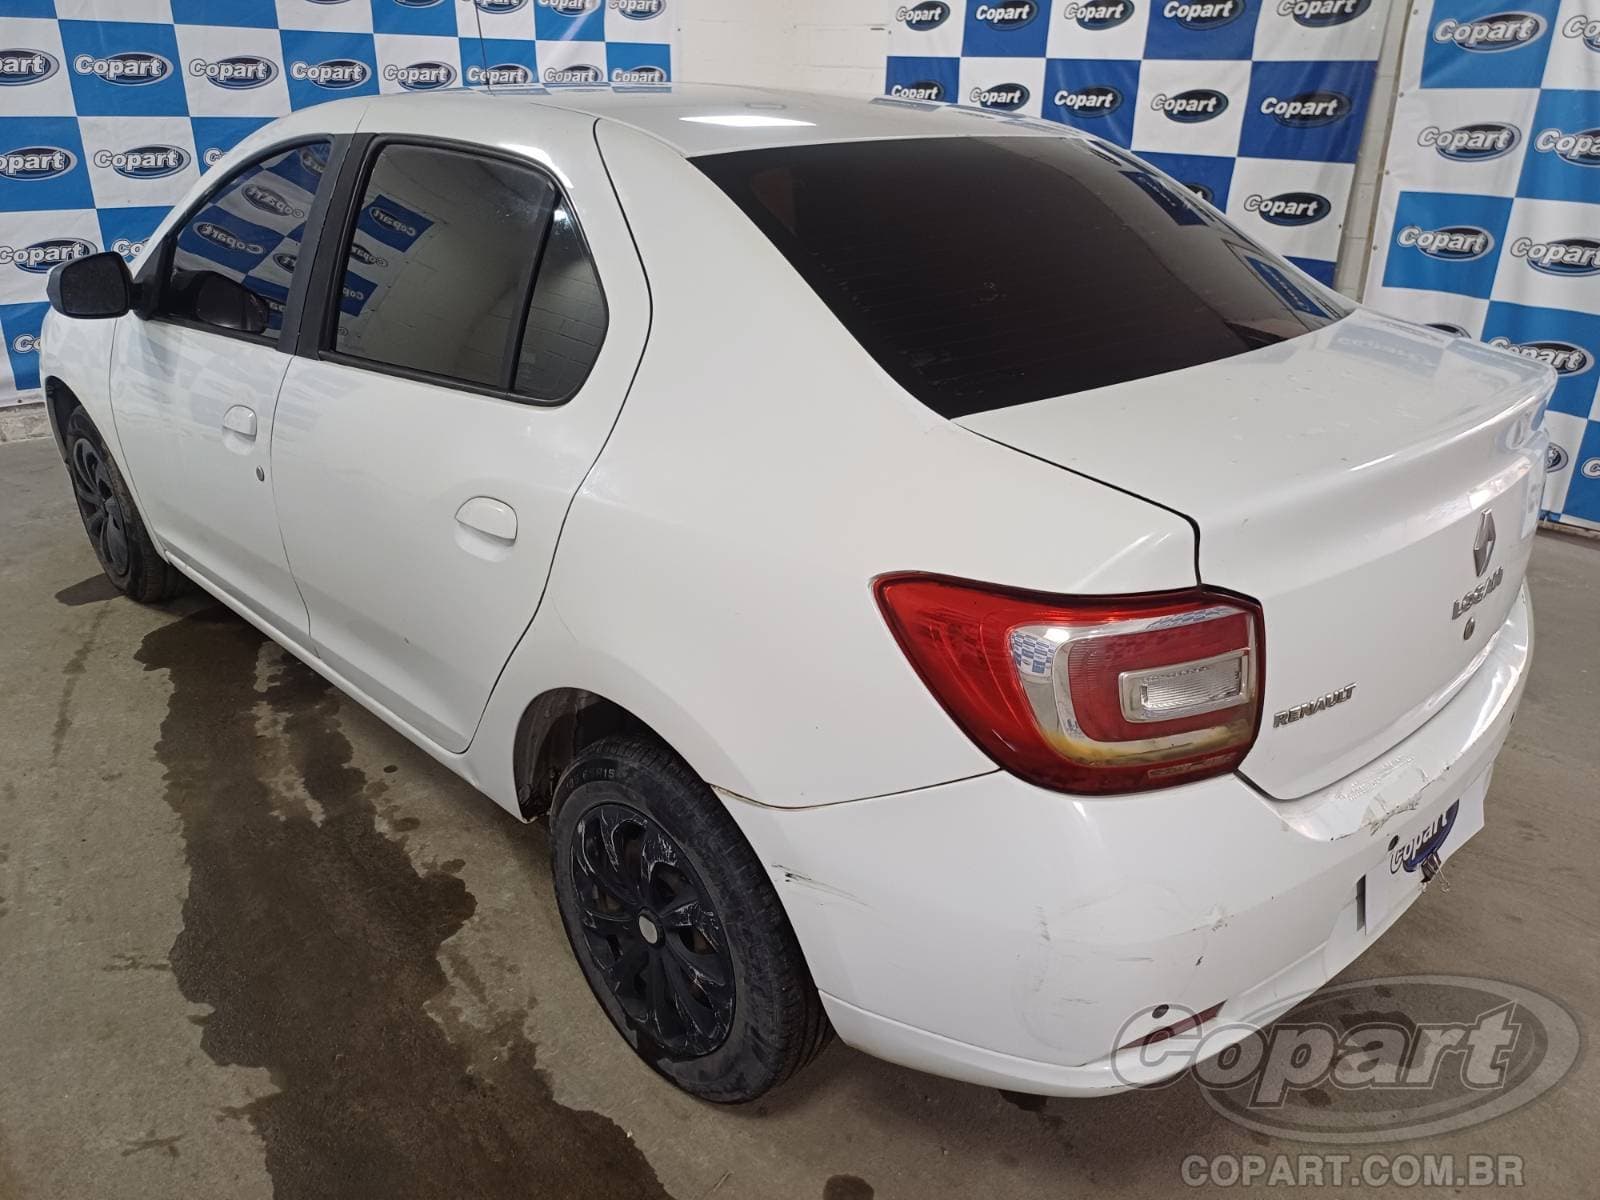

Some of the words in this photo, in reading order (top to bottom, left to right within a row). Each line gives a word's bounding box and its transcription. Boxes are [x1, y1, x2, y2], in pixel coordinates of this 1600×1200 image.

[896, 6, 942, 22] Copart
[975, 4, 1031, 23] Copart
[1064, 3, 1125, 23] Copart
[1163, 1, 1233, 21] Copart
[1277, 0, 1356, 17] Copart
[1433, 17, 1536, 47] Copart
[0, 54, 45, 74] art
[74, 54, 162, 80] Copart
[189, 59, 267, 83] Copart
[291, 62, 362, 84] Copart
[384, 64, 449, 83] Copart
[467, 66, 525, 85] Copart
[969, 87, 1021, 106] Copart
[1054, 90, 1114, 110] Copart
[1151, 94, 1217, 113] Copart
[1260, 97, 1338, 119] Copart
[1417, 126, 1512, 154] Copart
[1534, 128, 1600, 159] Copa
[94, 147, 178, 172] Copart
[1244, 194, 1318, 217] Copart
[1397, 225, 1487, 254] Copart
[0, 242, 86, 268] Copart
[1452, 566, 1504, 620] LOGAN
[1273, 682, 1357, 728] RENAULT
